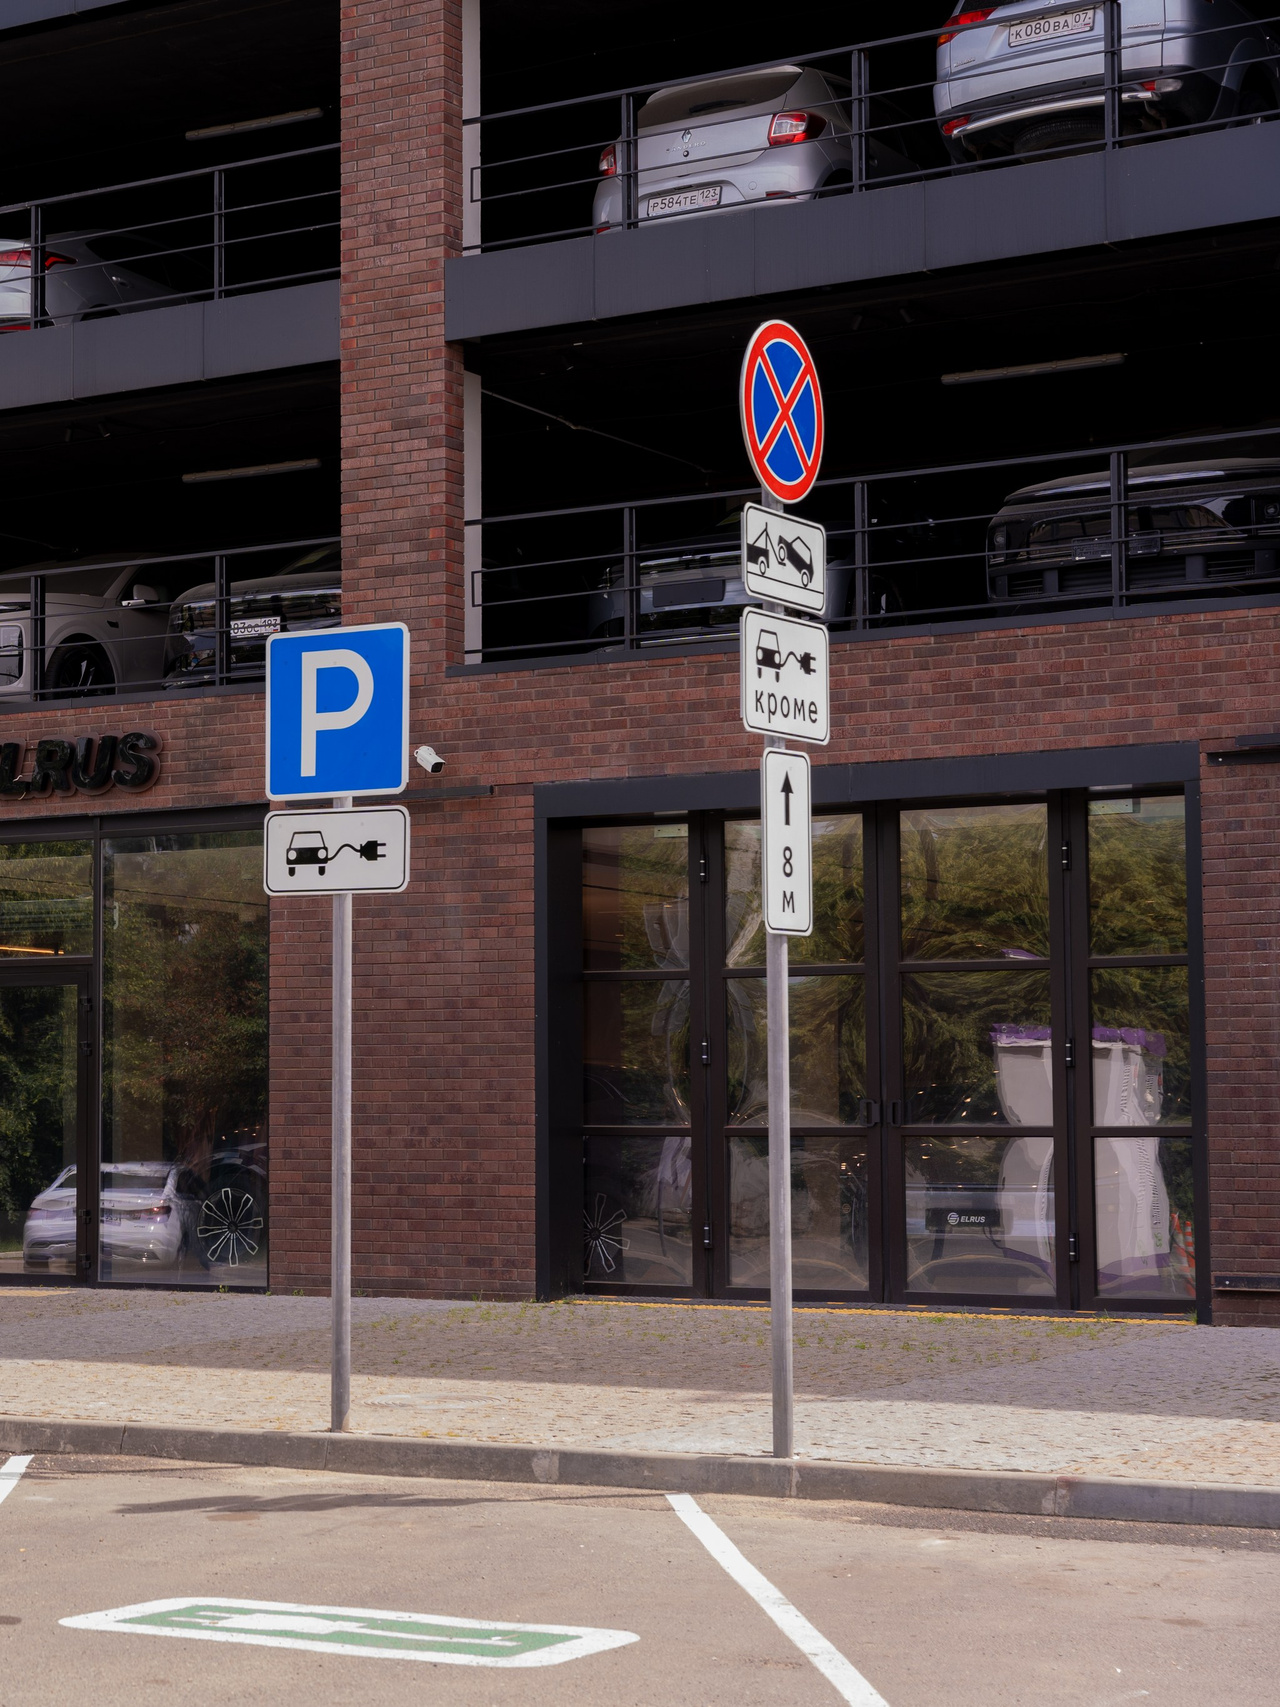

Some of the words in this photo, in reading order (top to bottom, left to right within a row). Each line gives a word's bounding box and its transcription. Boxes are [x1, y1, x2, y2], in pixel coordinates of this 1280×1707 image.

[1015, 20, 1070, 39] К080ВА
[1074, 12, 1089, 24] 07
[652, 195, 697, 211] Р584ТЕ
[699, 188, 718, 199] 123
[301, 649, 374, 777] P
[755, 690, 818, 723] кроме
[783, 846, 793, 878] 8
